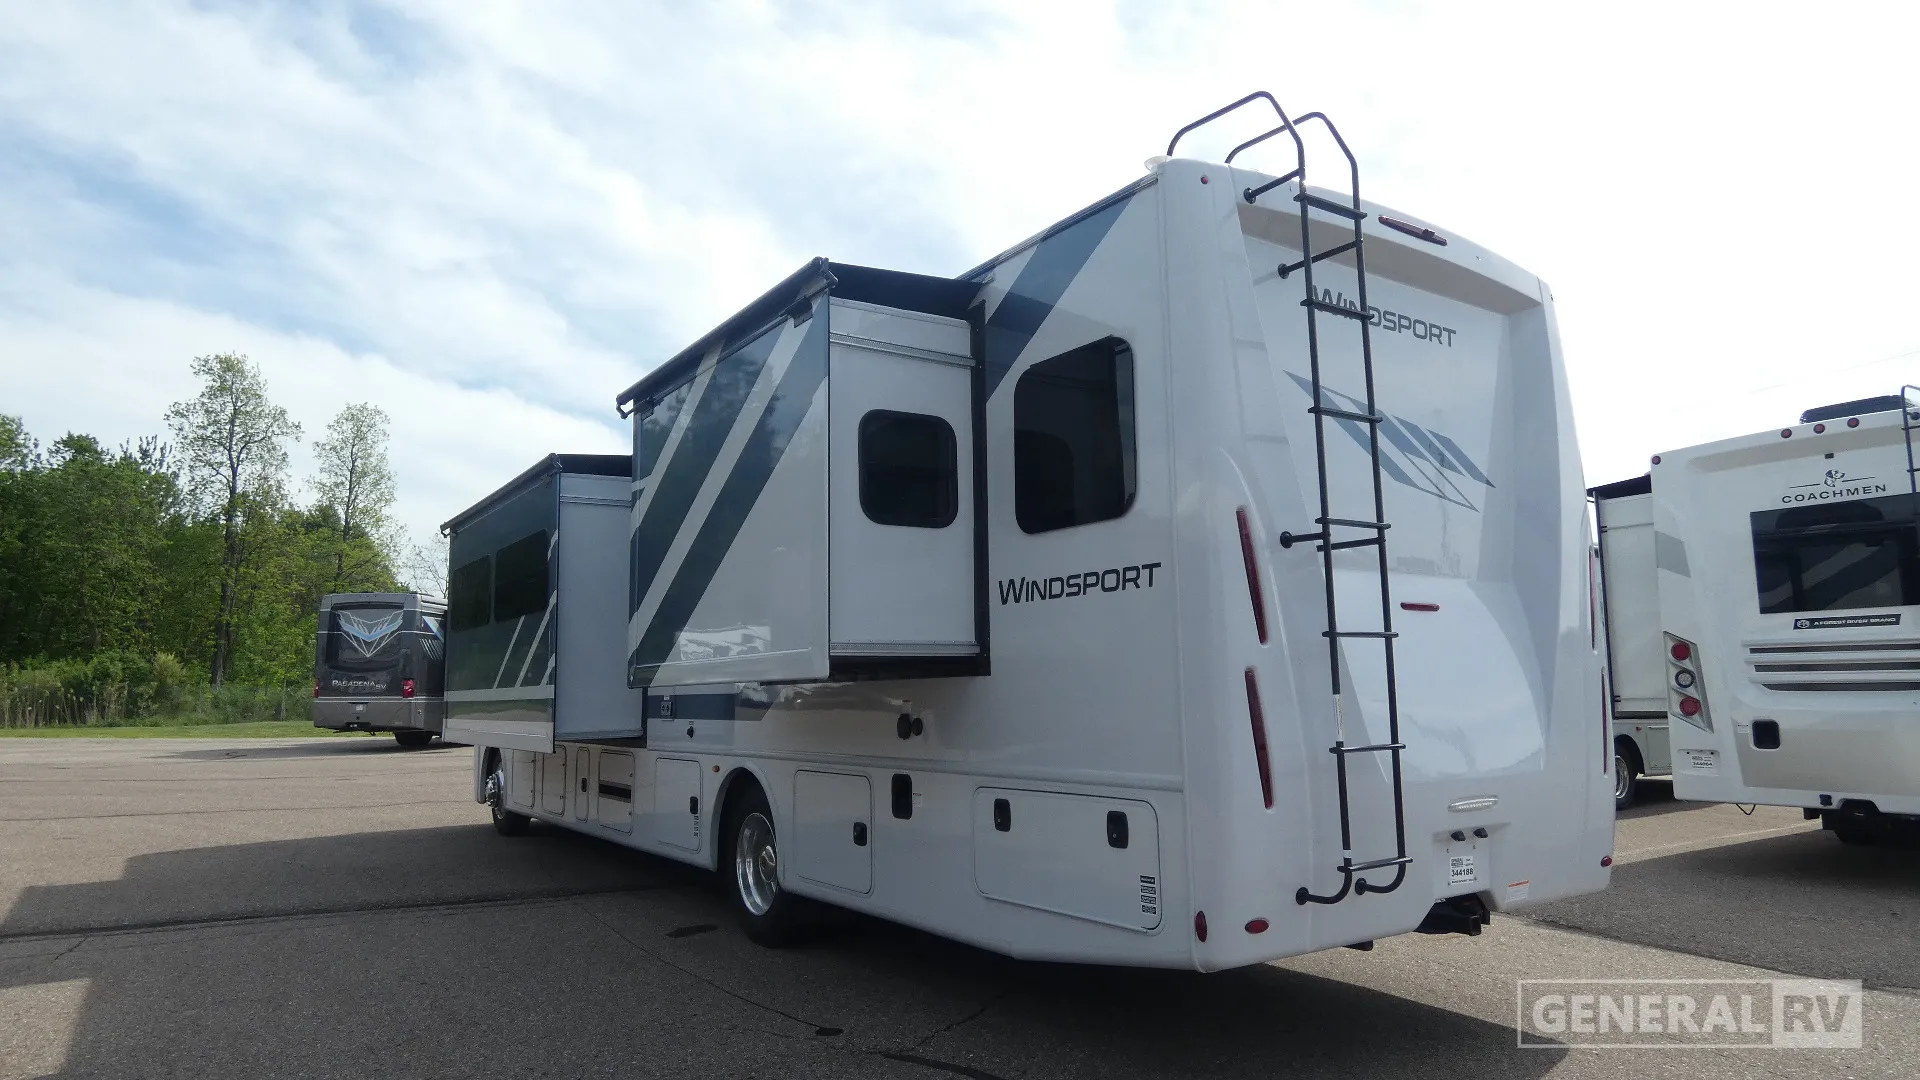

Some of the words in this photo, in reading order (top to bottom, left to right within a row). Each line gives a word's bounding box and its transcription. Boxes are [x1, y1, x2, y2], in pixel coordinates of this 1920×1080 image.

[1781, 484, 1887, 504] COACHMEN
[998, 561, 1162, 606] WINDSPORT
[332, 679, 376, 687] PASADENA
